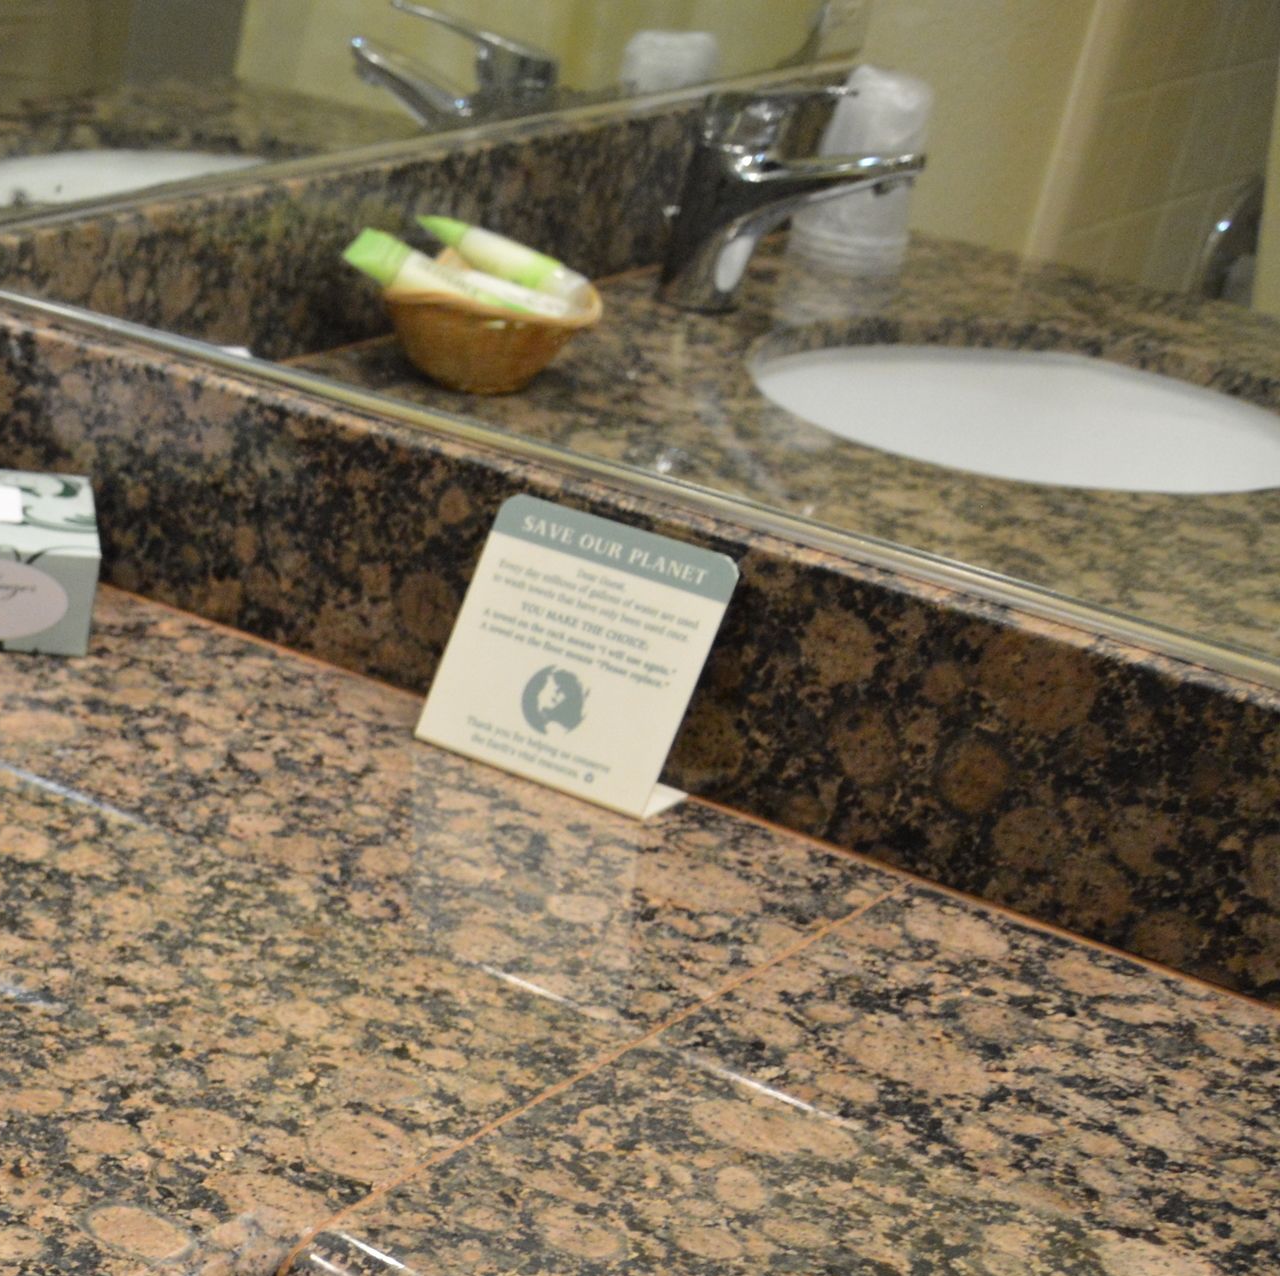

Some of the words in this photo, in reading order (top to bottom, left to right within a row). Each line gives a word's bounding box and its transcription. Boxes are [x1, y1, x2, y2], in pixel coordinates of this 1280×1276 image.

[522, 515, 575, 544] SAVE
[579, 534, 623, 563] OUR
[628, 549, 708, 585] PLANET
